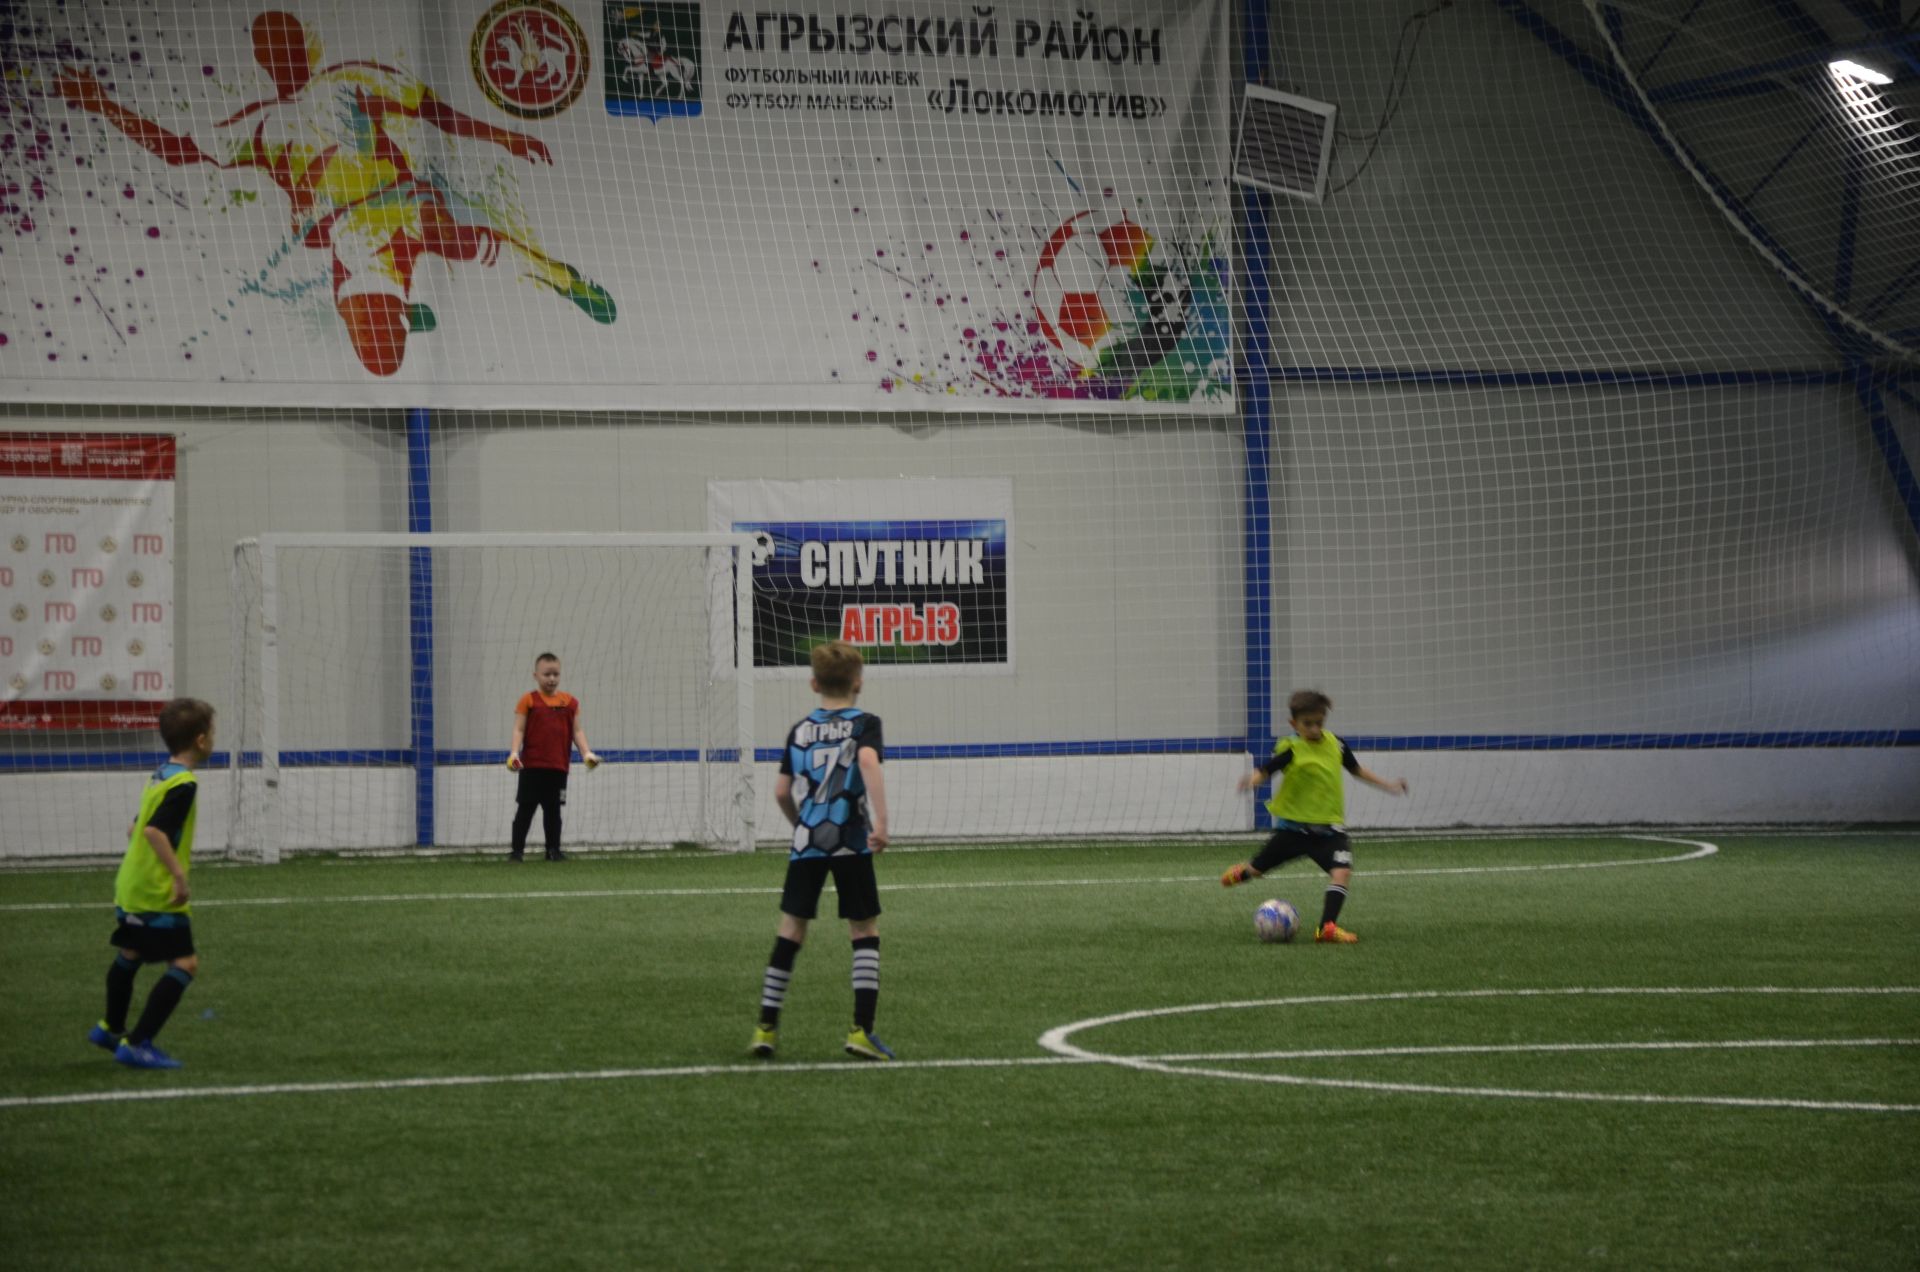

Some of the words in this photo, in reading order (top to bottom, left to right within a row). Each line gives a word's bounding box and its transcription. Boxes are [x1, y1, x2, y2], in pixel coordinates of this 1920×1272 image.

[724, 6, 998, 58] АГРЫЗСКИЙ
[1015, 9, 1160, 65] РАЙОН
[725, 67, 849, 85] ФУТБОЛЬНЫЙ
[855, 70, 919, 86] МАНЕЖ
[726, 93, 800, 109] ФУТБОЛ
[806, 95, 893, 111] МАНЕЖЫ
[800, 538, 987, 588] СПУТНИК
[840, 603, 960, 646] АГРЫЗ
[803, 722, 853, 744] АГРЫЗ
[813, 747, 840, 803] 7
